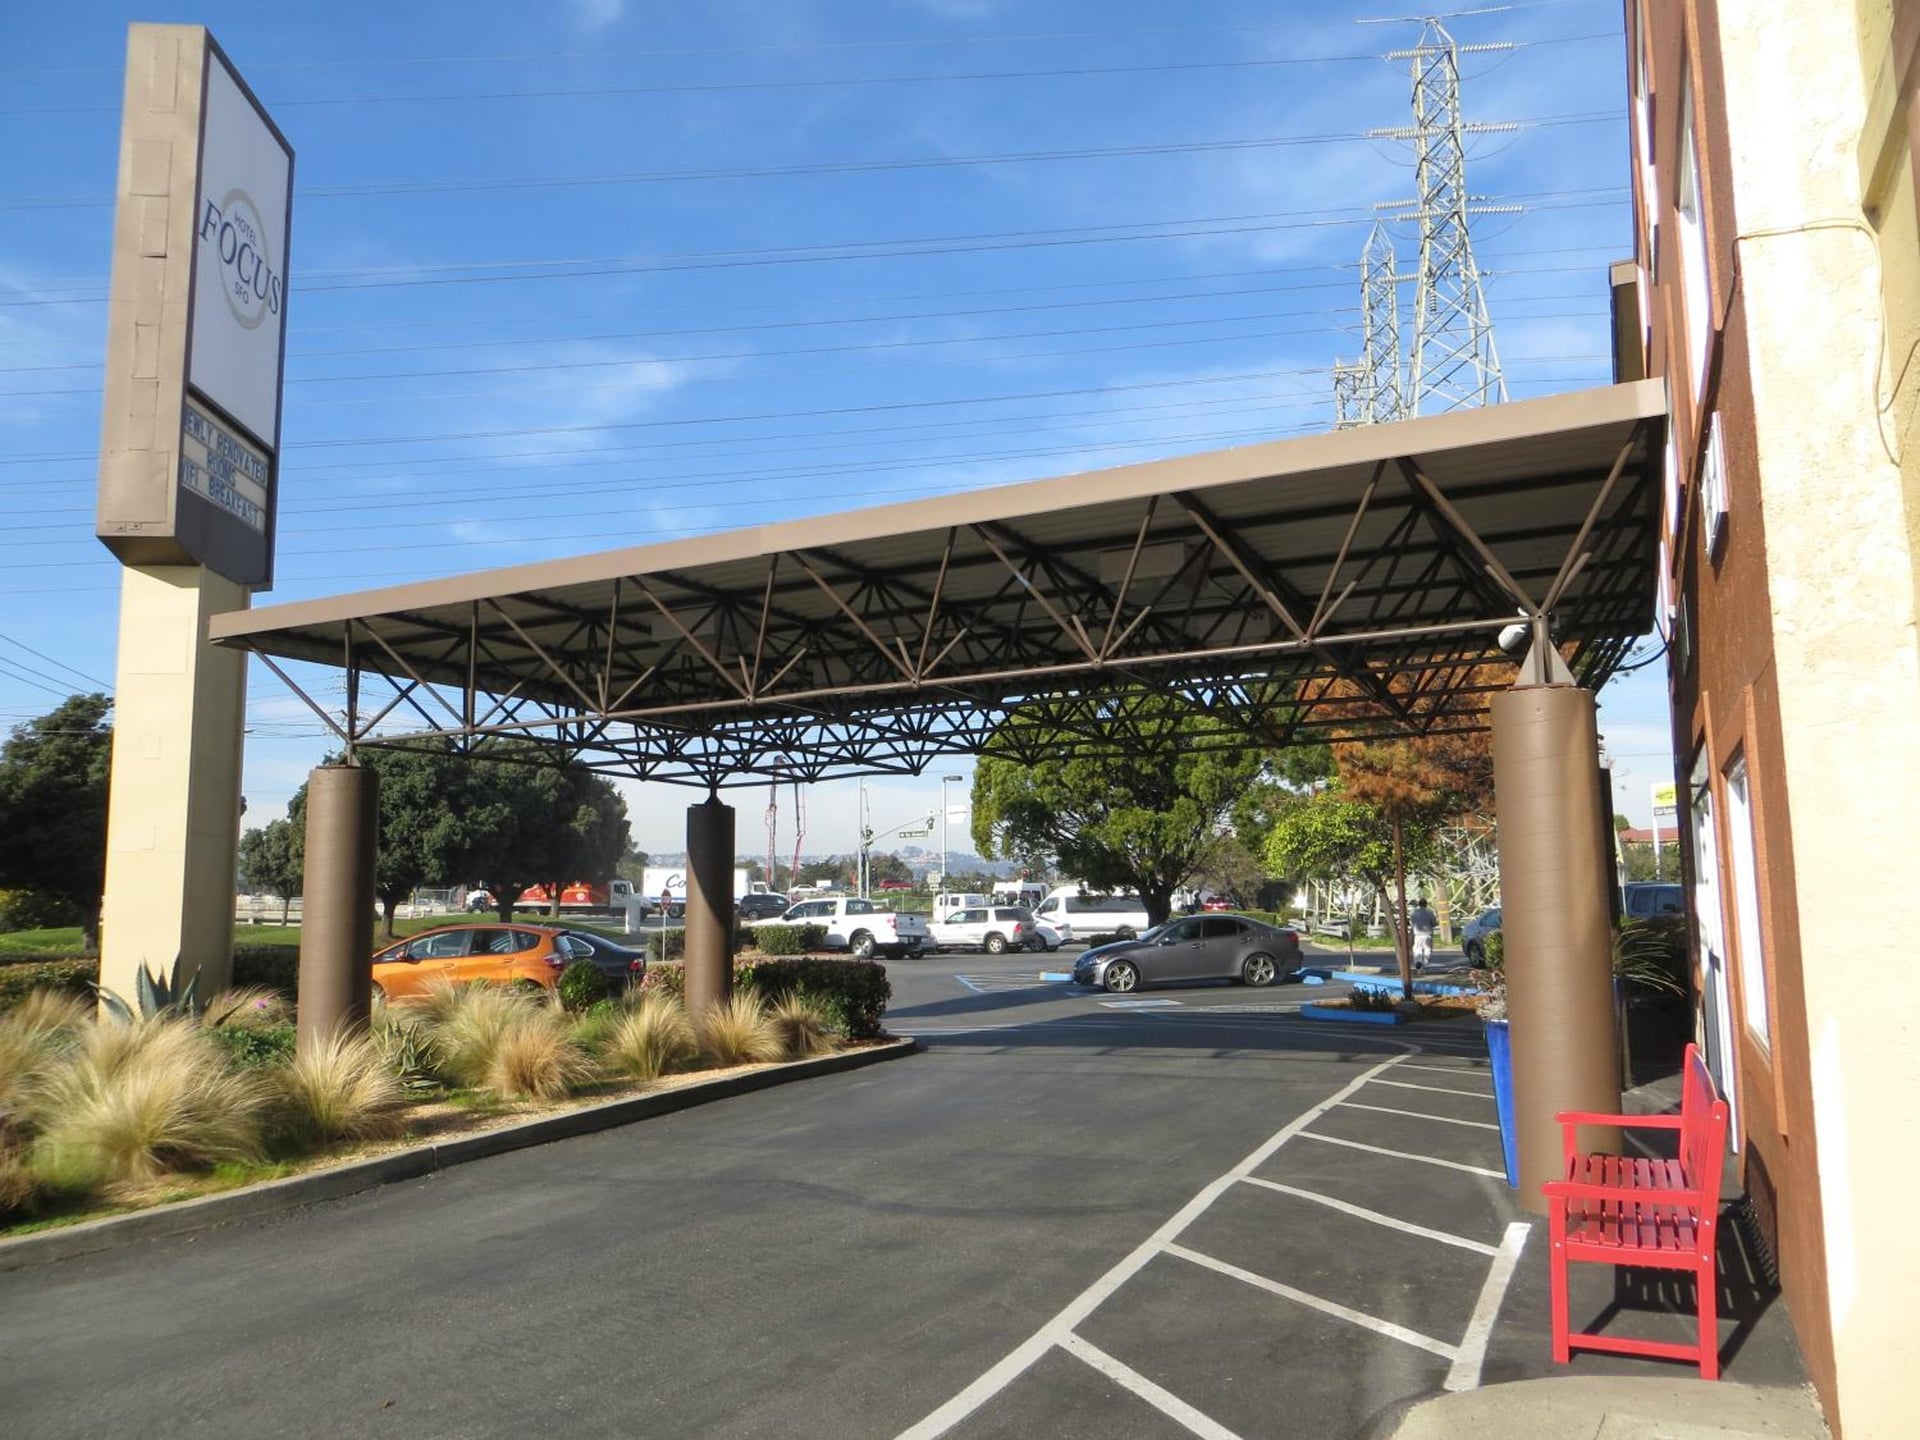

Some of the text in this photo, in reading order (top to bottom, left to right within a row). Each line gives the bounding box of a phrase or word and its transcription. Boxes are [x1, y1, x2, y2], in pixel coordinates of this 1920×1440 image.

[235, 211, 256, 247] HOTEL
[200, 199, 280, 315] FOCUS
[217, 432, 266, 485] RENOVATED
[210, 477, 257, 525] BREAKFAST
